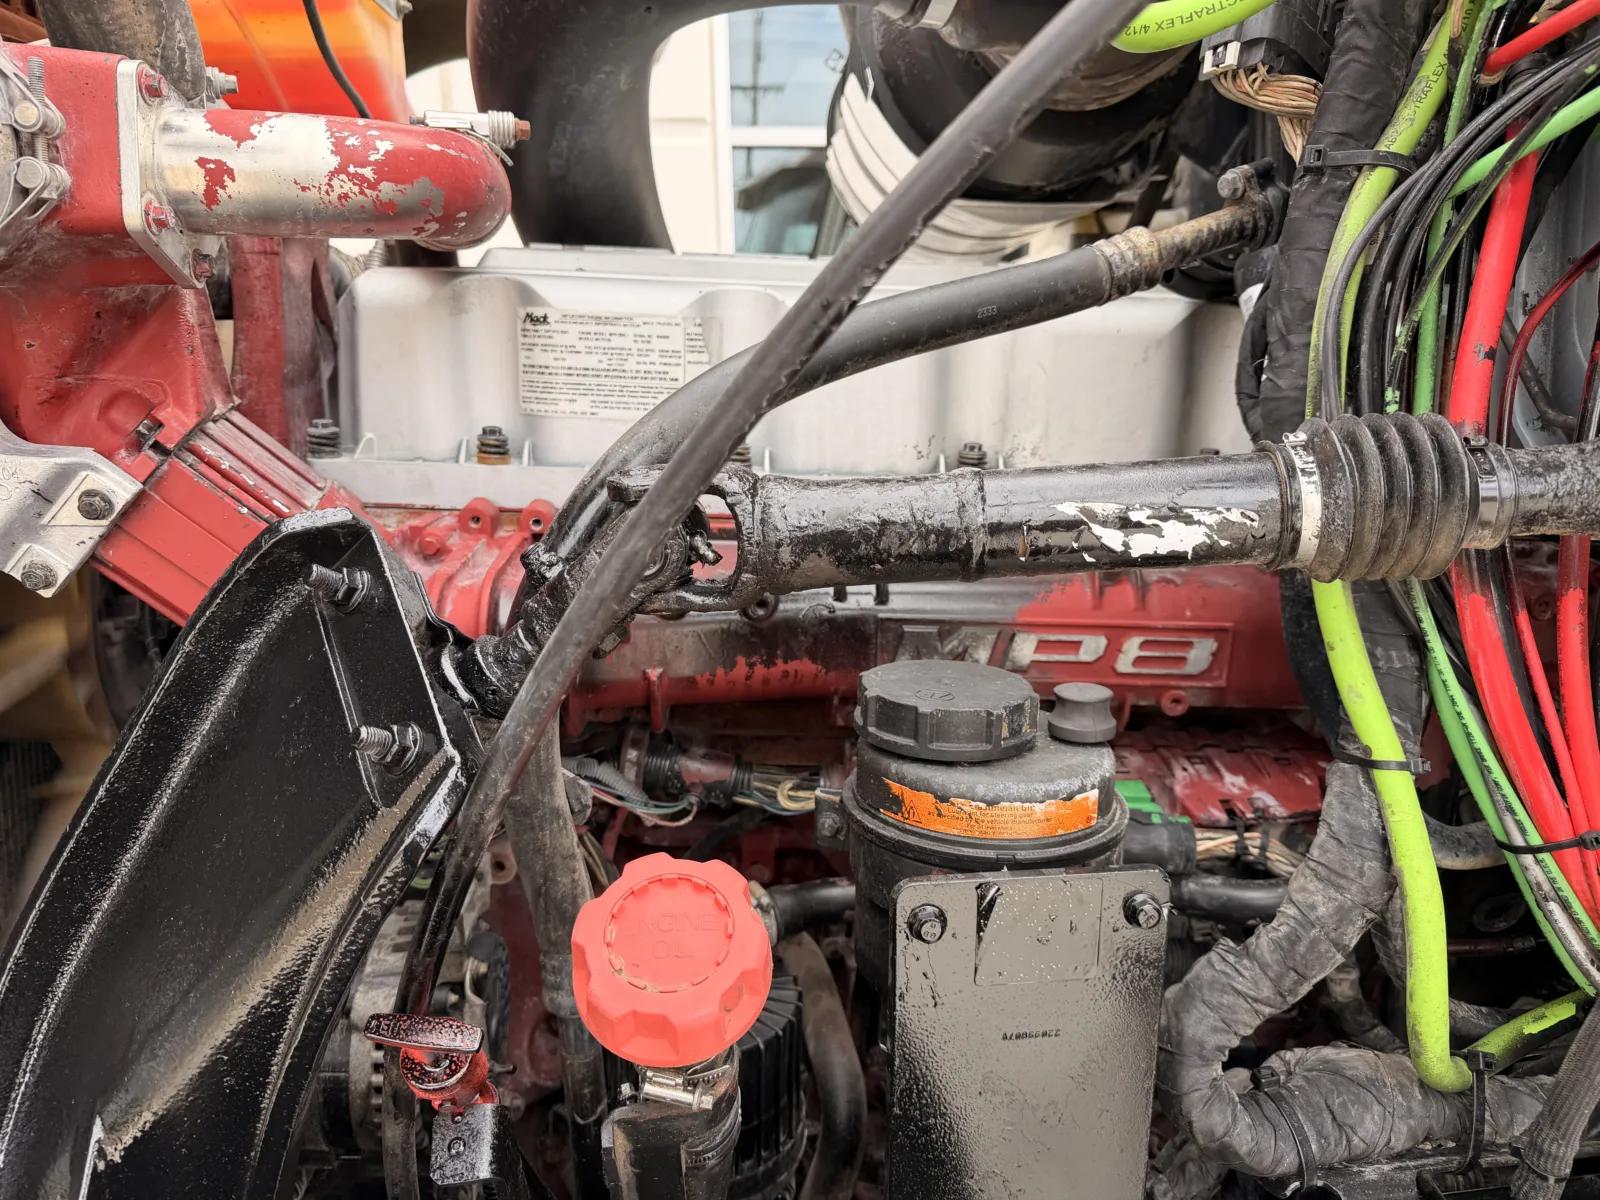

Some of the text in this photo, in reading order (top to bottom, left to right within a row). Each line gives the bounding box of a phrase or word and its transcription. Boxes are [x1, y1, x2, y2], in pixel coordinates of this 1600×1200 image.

[1124, 0, 1240, 36] CTRAFLEX 4/12
[523, 311, 551, 326] Mack
[976, 305, 998, 319] 2333
